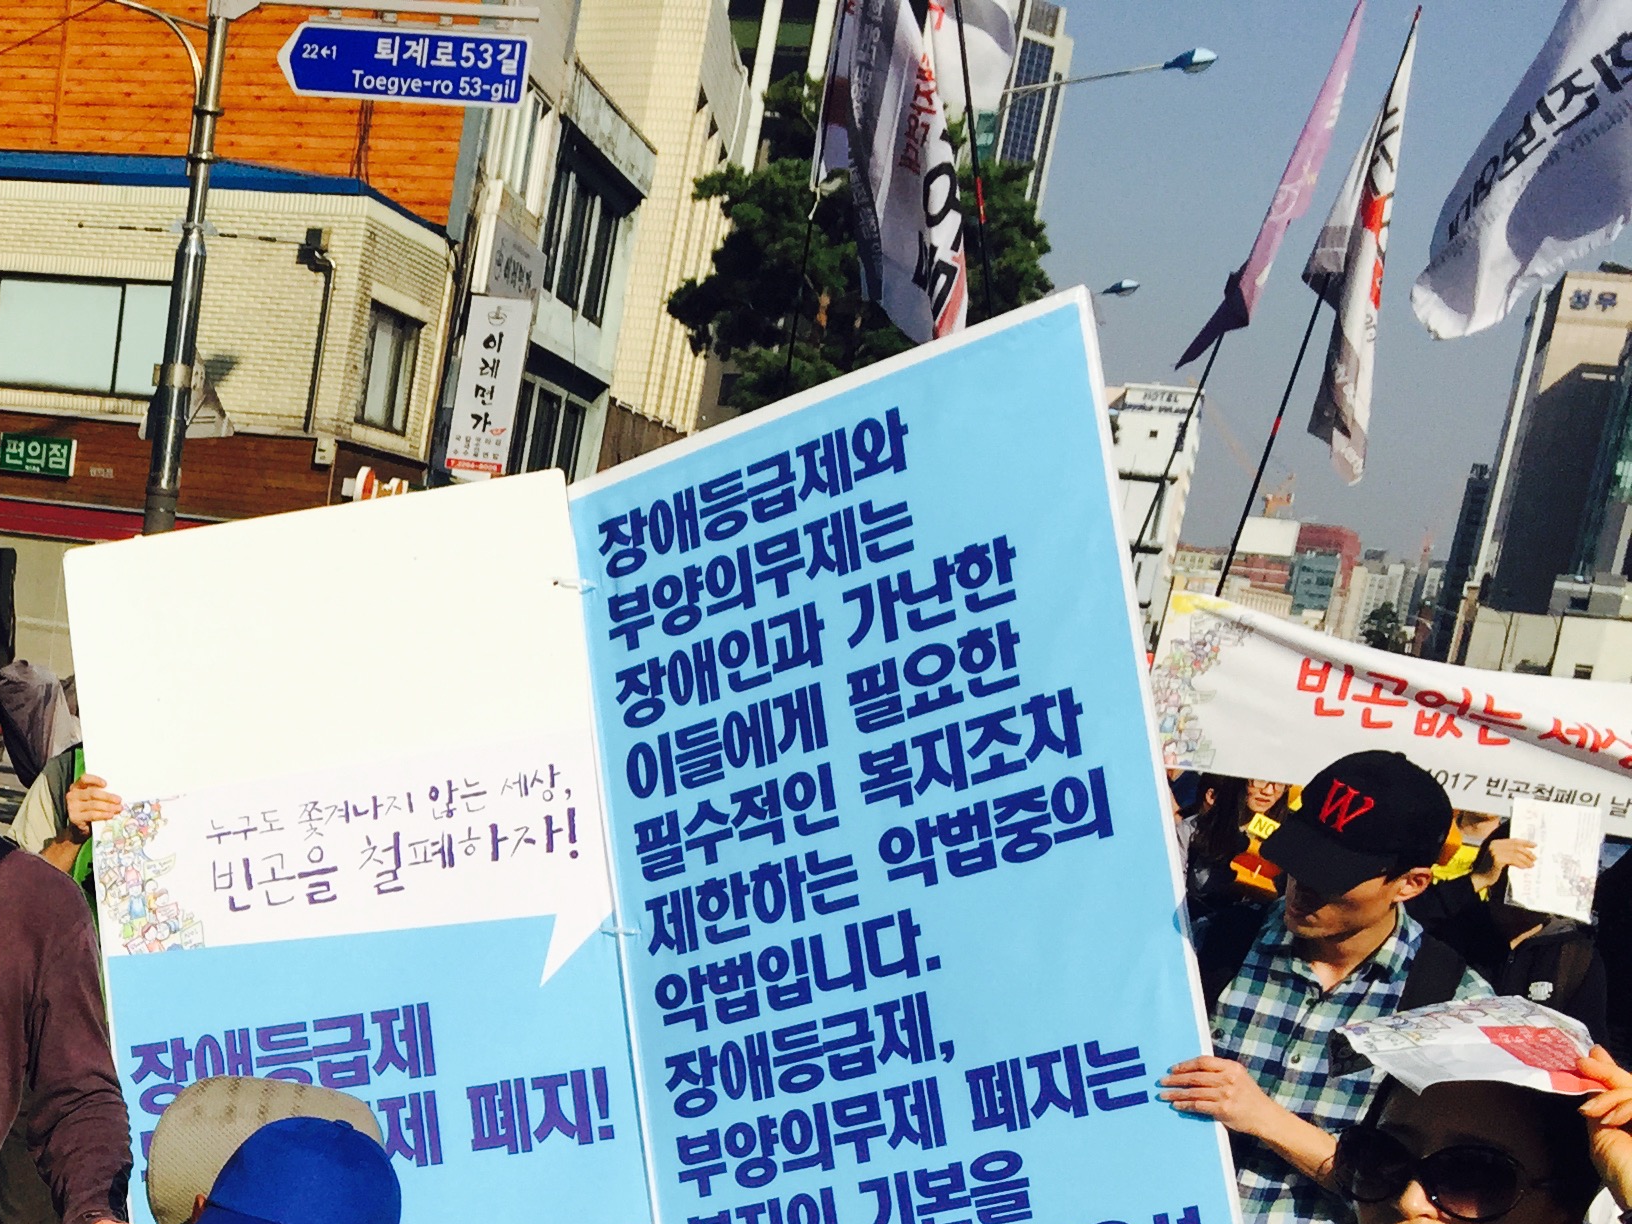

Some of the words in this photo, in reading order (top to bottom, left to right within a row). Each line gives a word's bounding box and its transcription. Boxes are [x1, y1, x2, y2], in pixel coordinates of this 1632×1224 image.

[351, 69, 454, 96] Toegye-ro
[458, 79, 516, 102] 53-gil
[373, 35, 521, 76] 퇴계로53길
[470, 331, 505, 434] 이레면가
[5, 439, 69, 470] 편의점
[598, 406, 909, 579] 장애등급제와
[607, 499, 914, 652] 부양의무제는
[614, 602, 825, 729] 장애인과
[841, 534, 1017, 649] 가난한
[626, 682, 829, 799] 이들에게
[846, 619, 1021, 735] 필요한
[1296, 656, 1527, 746] 빈곤없는
[205, 809, 286, 844] 누구도
[297, 791, 415, 841] 쫓겨나지
[428, 776, 487, 822] 않는
[500, 763, 572, 804] 세상,
[634, 762, 840, 883] 필수적인
[858, 686, 1084, 808] 복지조차
[1318, 778, 1375, 833] W
[1426, 768, 1478, 791] 017
[212, 844, 339, 912] 빈곤을
[358, 807, 579, 896] 철폐하자!
[645, 849, 861, 956] 제한하는
[878, 766, 1114, 888] 악법중의
[654, 908, 942, 1032] 악법입니다.
[130, 1001, 437, 1116] 장애등급제
[466, 1065, 616, 1155] 폐지!
[664, 991, 955, 1119] 장애등급제,
[676, 1076, 947, 1199] 부양의무제
[965, 1040, 1149, 1133] 폐지는
